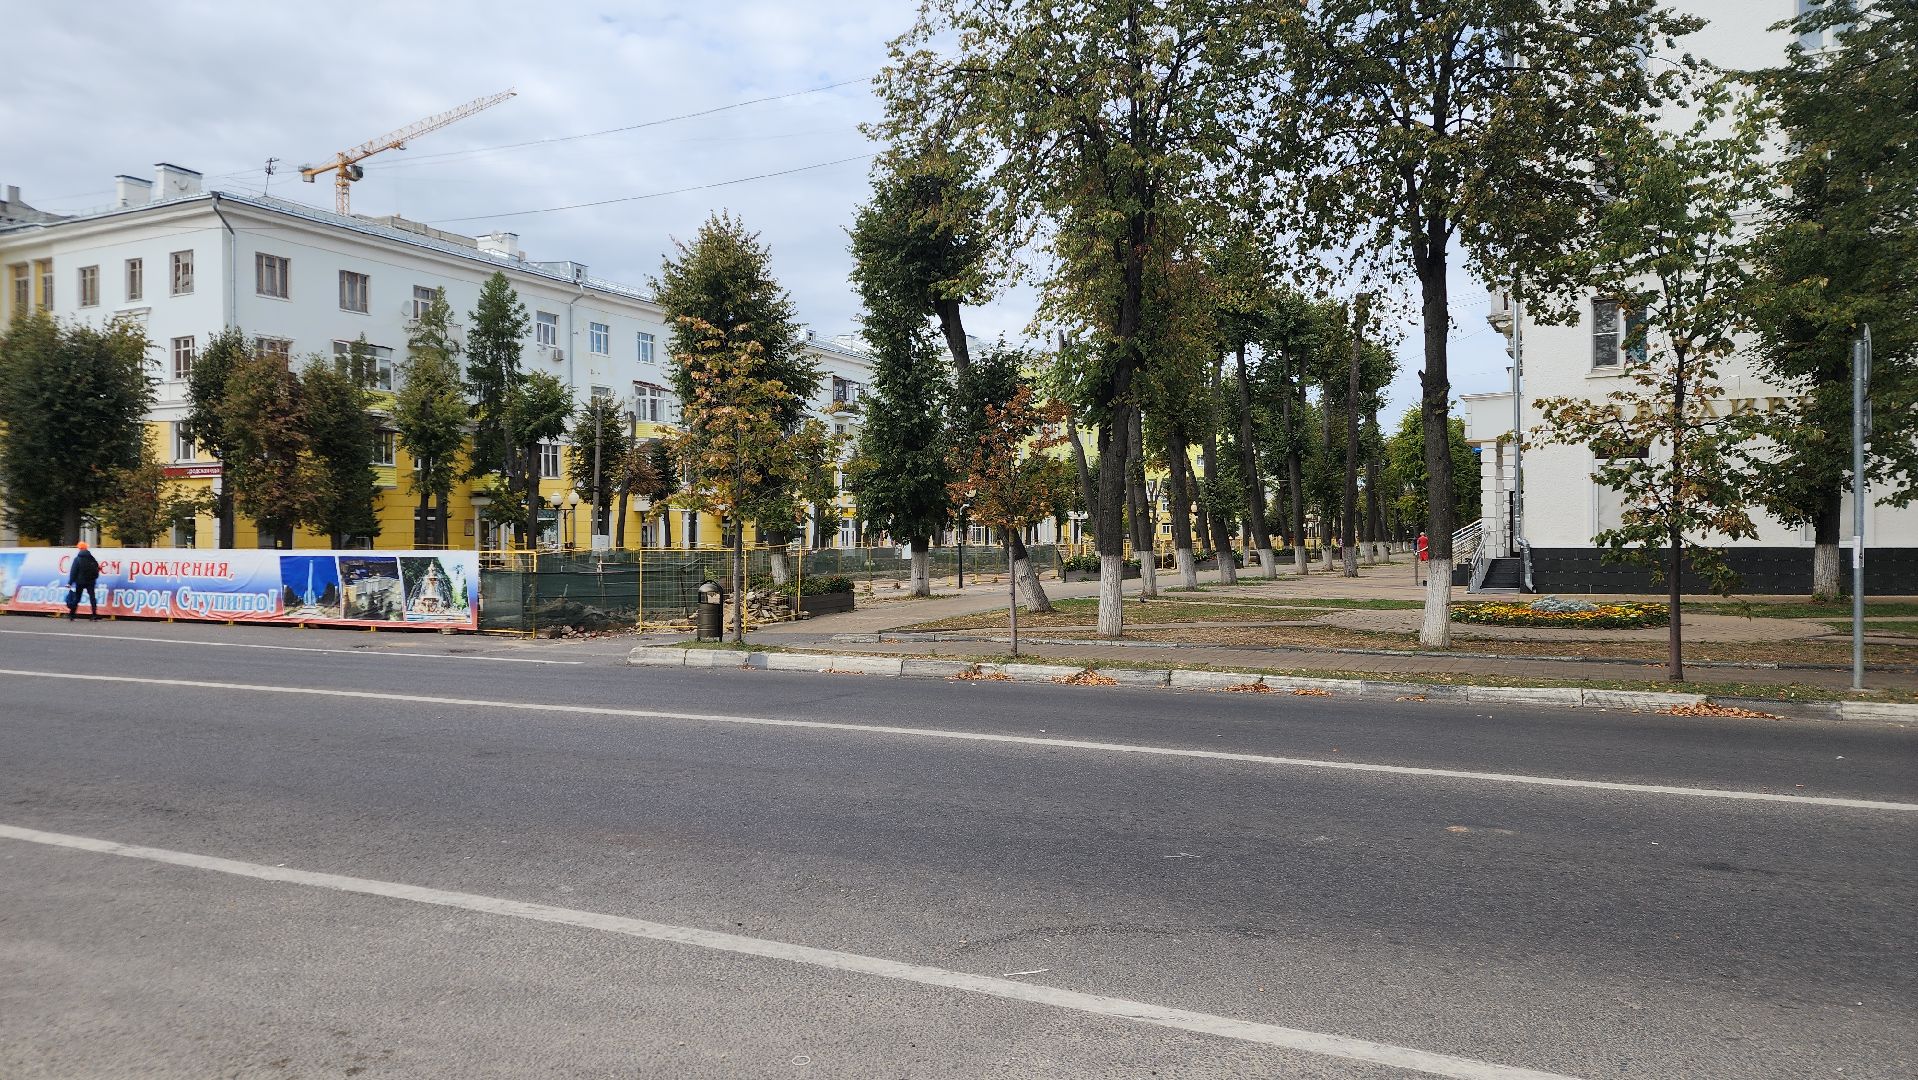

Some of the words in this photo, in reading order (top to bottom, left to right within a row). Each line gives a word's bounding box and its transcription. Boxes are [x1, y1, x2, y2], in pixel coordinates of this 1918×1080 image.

[60, 555, 70, 573] С
[130, 560, 234, 581] рождения,
[17, 582, 109, 606] любиый
[113, 588, 171, 613] город
[177, 586, 278, 615] Ступино!
